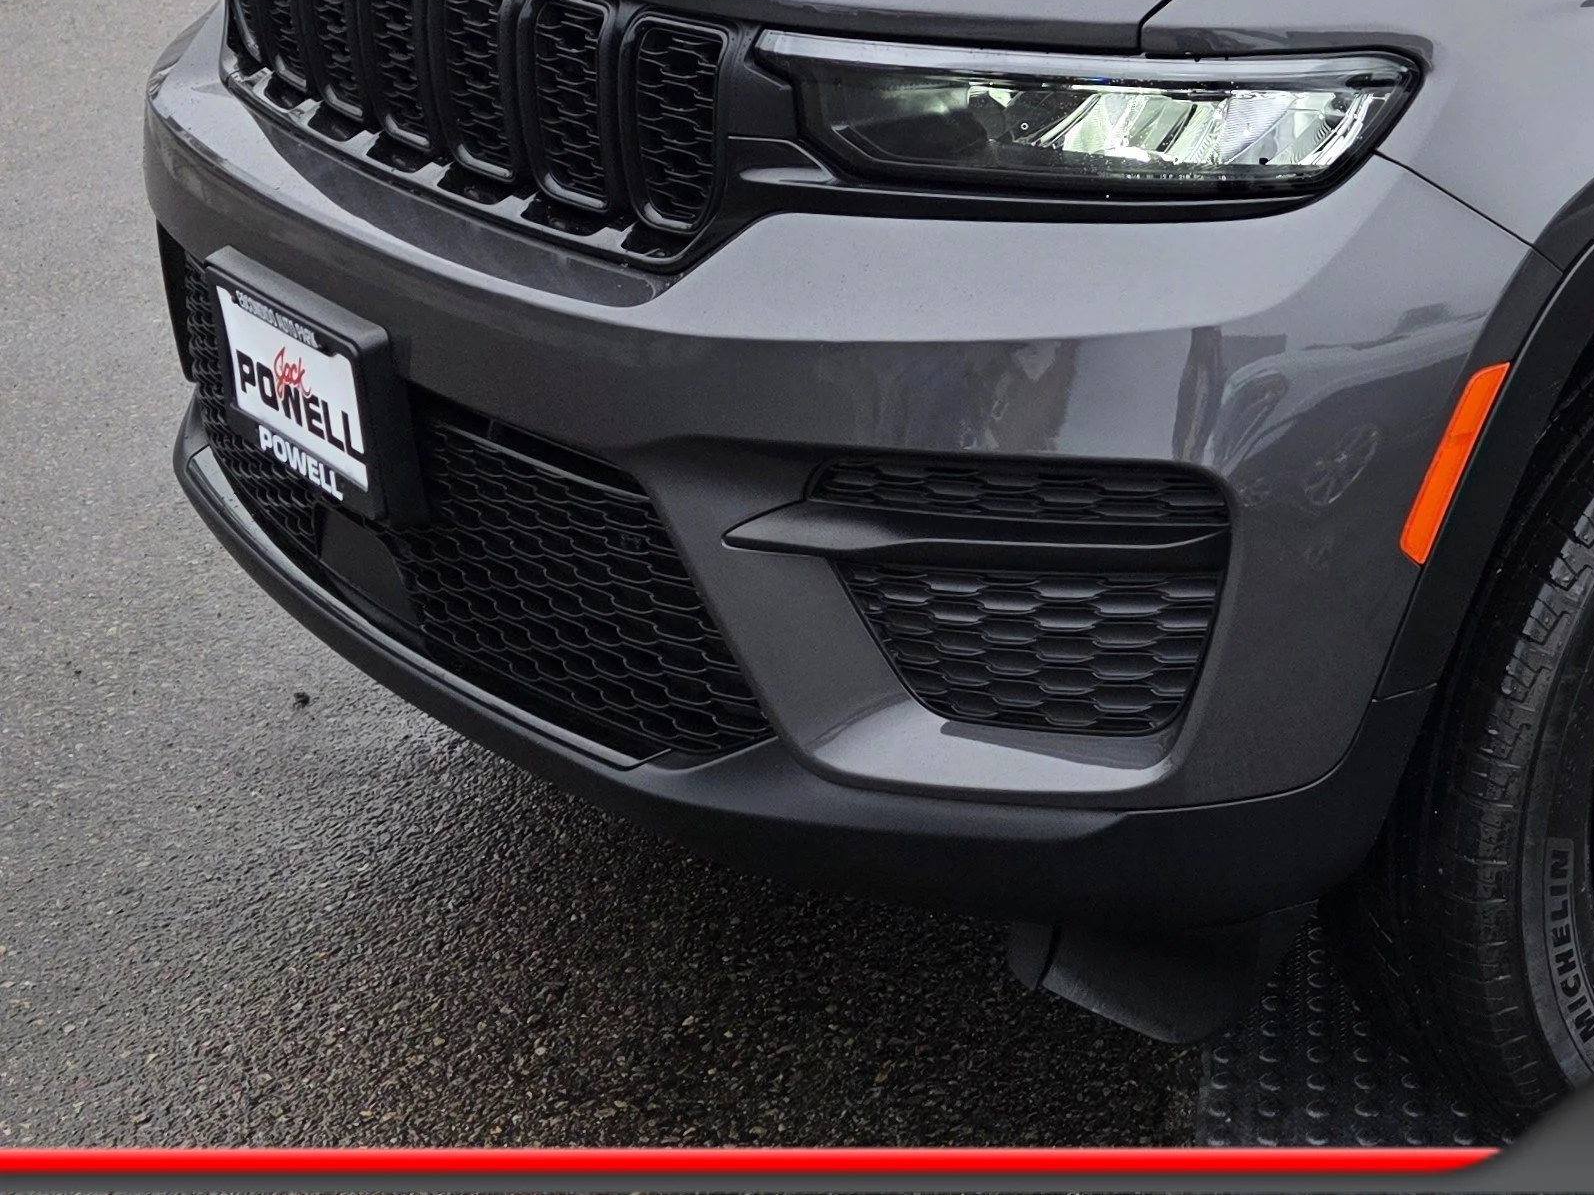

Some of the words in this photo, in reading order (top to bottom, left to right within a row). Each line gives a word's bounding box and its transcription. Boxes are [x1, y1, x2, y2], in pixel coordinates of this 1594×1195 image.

[235, 349, 366, 464] POWELL
[274, 346, 311, 397] Jack
[258, 424, 344, 502] POWELL
